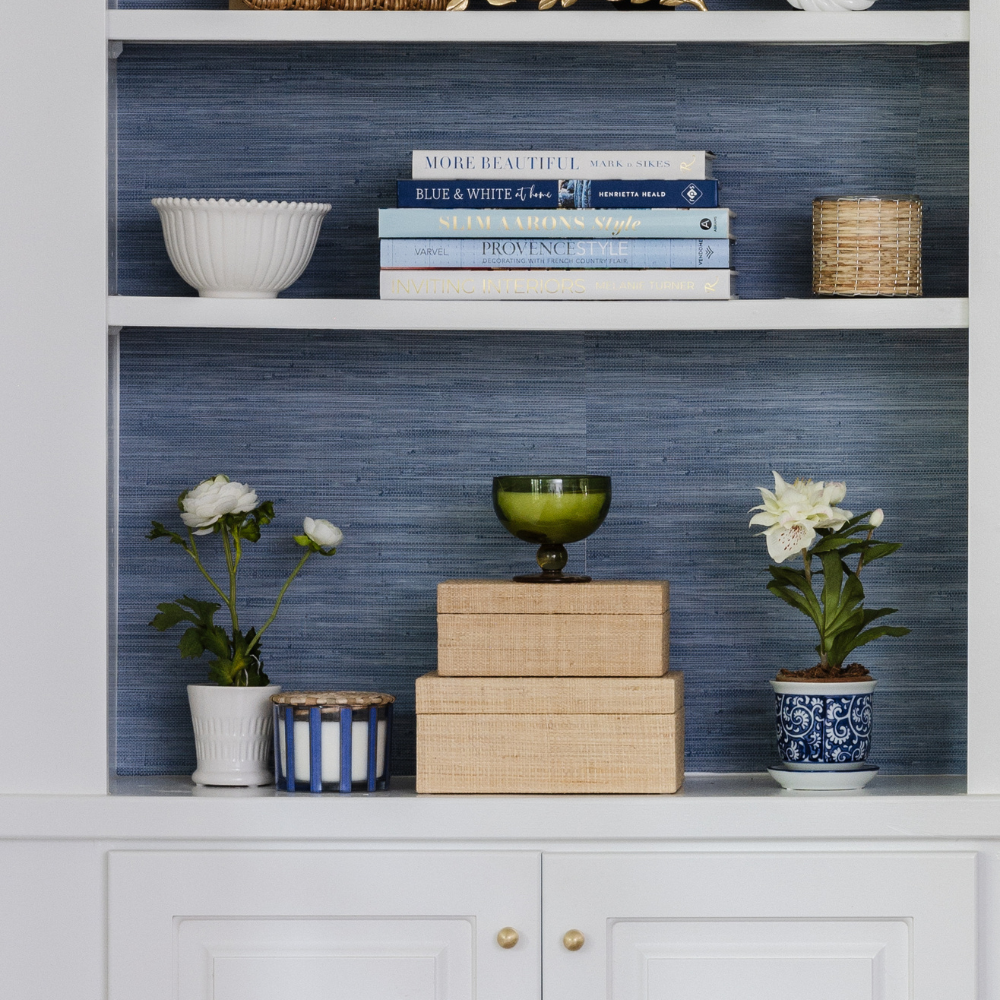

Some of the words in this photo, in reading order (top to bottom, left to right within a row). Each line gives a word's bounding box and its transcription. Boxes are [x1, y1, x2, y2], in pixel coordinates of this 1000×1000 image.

[425, 156, 475, 169] MORE
[481, 156, 579, 170] BEAUTIFUL
[590, 160, 623, 168] MARK
[636, 160, 671, 168] SIKES
[416, 188, 450, 200] BLUE
[453, 188, 464, 200] &
[467, 188, 512, 200] WHITE
[515, 187, 527, 200] at
[530, 184, 552, 199] home
[439, 215, 491, 231] SLIM
[497, 215, 585, 231] AARONS
[591, 214, 642, 236] Style
[415, 248, 448, 256] VARVEL
[391, 279, 476, 294] INVITING
[482, 278, 586, 294] INTERIORS
[595, 281, 645, 290] MELANIE
[649, 281, 695, 290] TURNER
